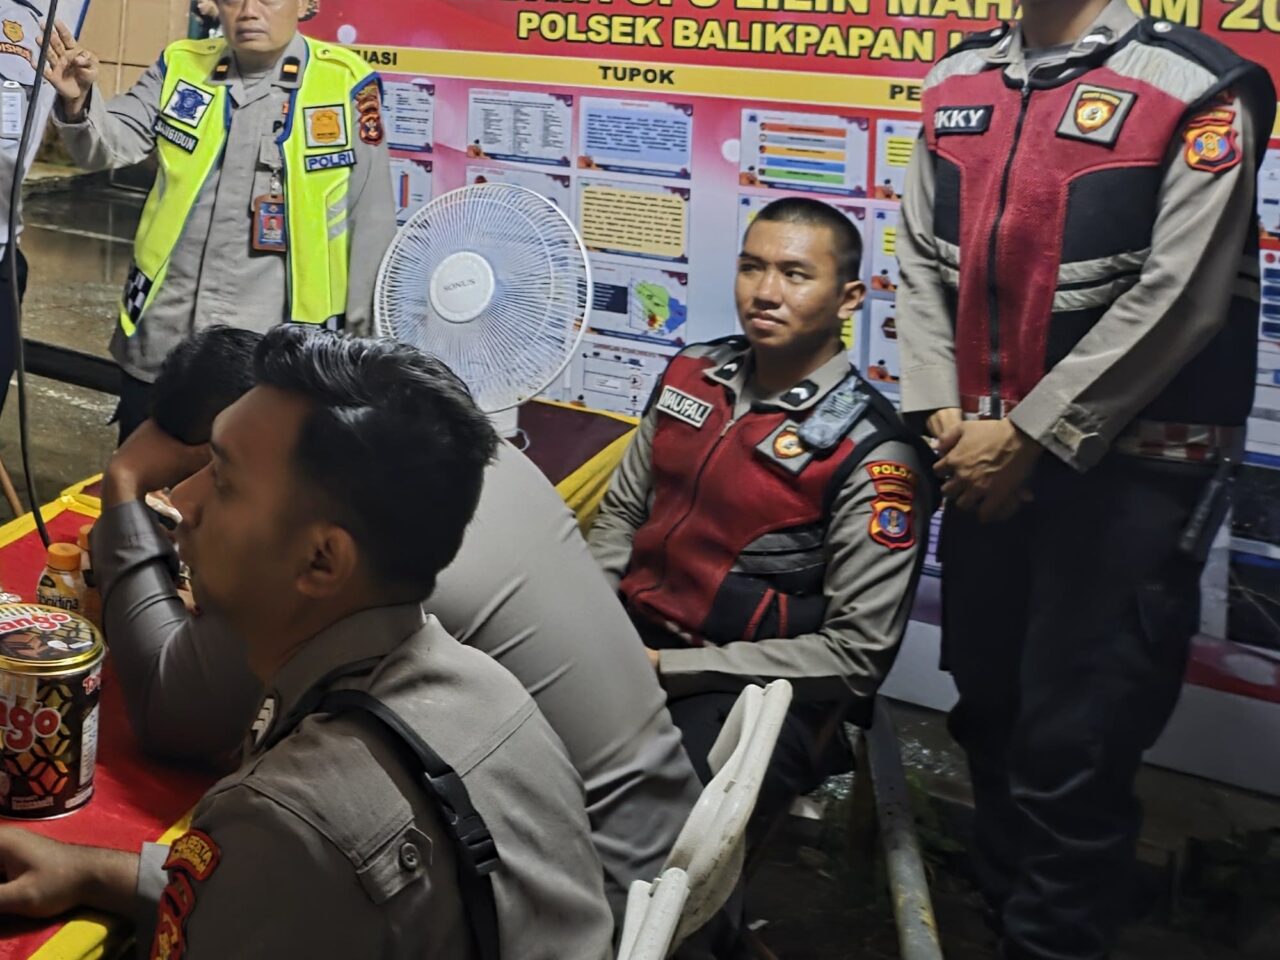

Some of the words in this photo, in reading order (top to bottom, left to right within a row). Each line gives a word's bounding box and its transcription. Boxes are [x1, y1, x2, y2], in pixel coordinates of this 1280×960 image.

[518, 11, 663, 47] POLSEK
[672, 18, 934, 62] BALIKPAPAN
[599, 65, 675, 85] TUPOK
[308, 151, 353, 170] POLRI
[660, 388, 706, 424] NAUFAL
